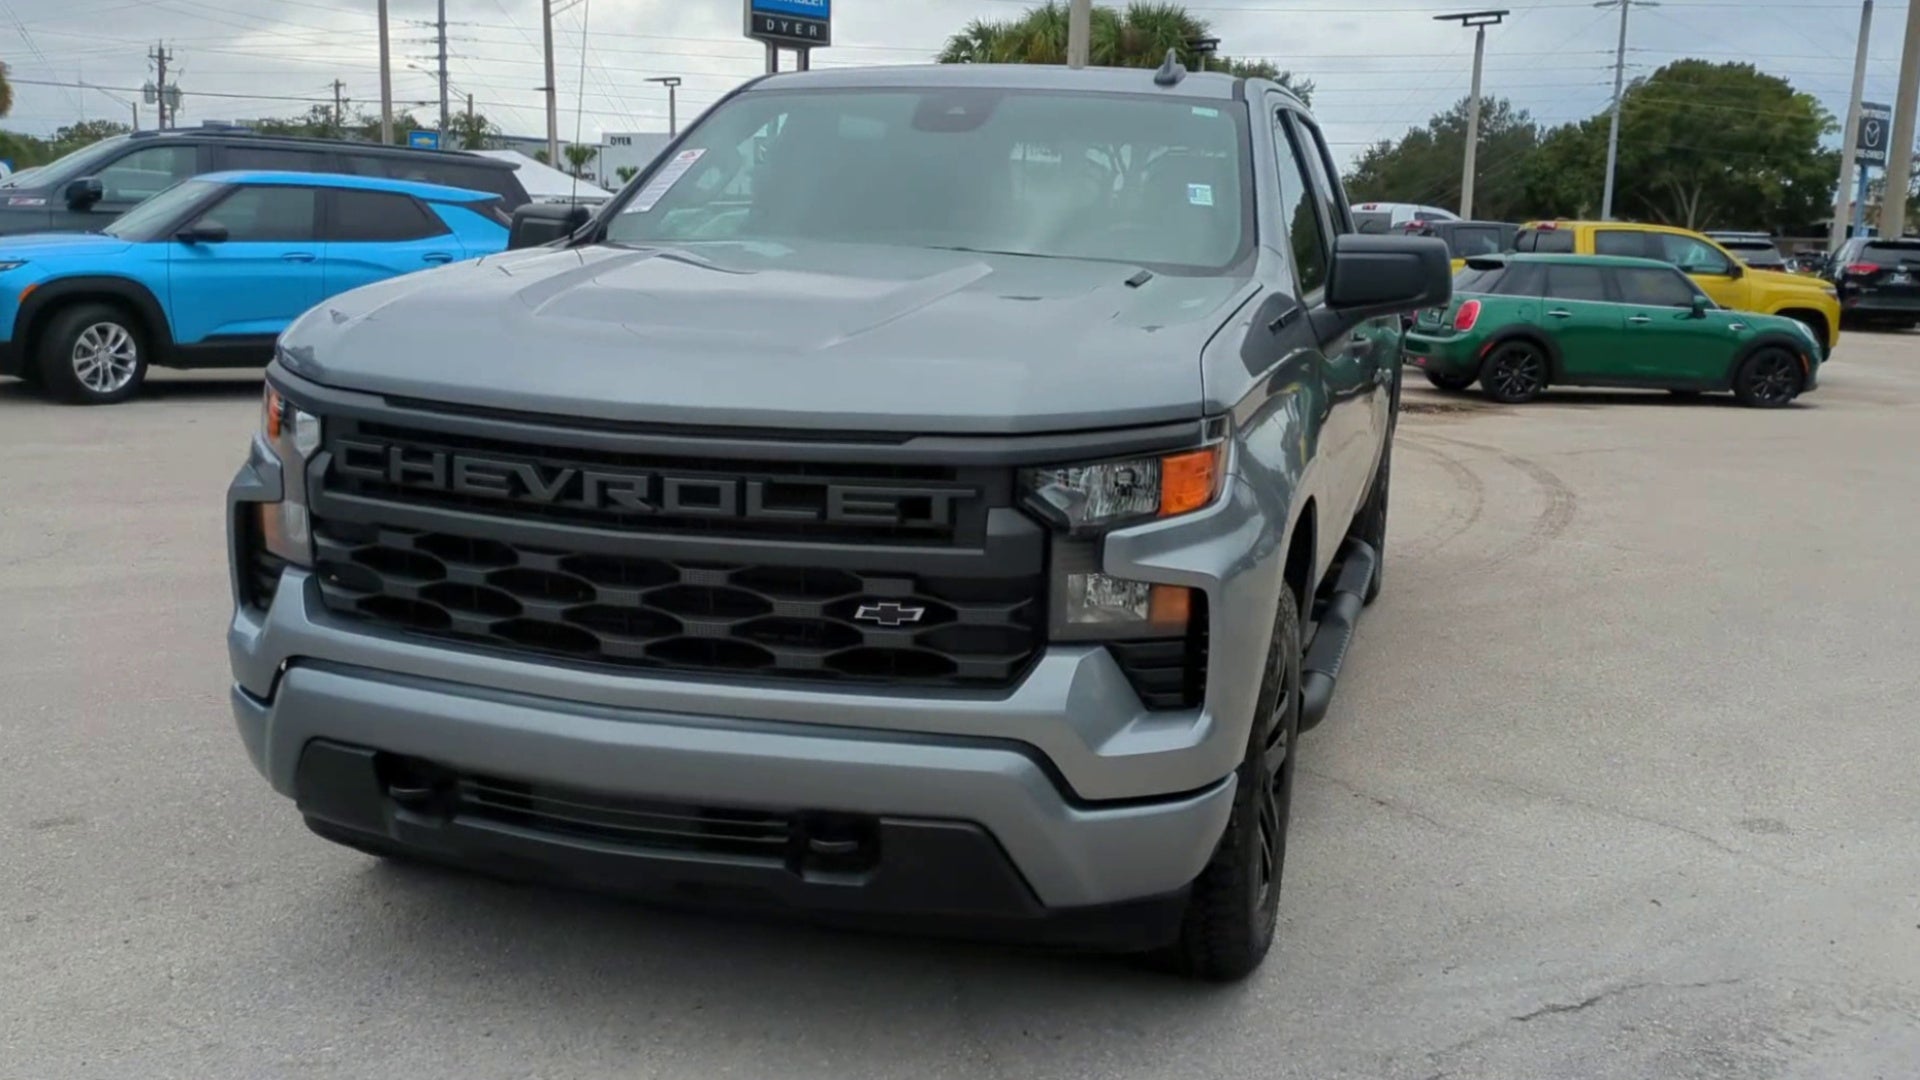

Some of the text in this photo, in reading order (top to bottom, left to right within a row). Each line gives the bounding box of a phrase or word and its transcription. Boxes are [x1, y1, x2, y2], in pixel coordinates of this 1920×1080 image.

[766, 18, 817, 37] DYER
[610, 136, 632, 146] DYER
[334, 438, 978, 529] CHEVROLET
